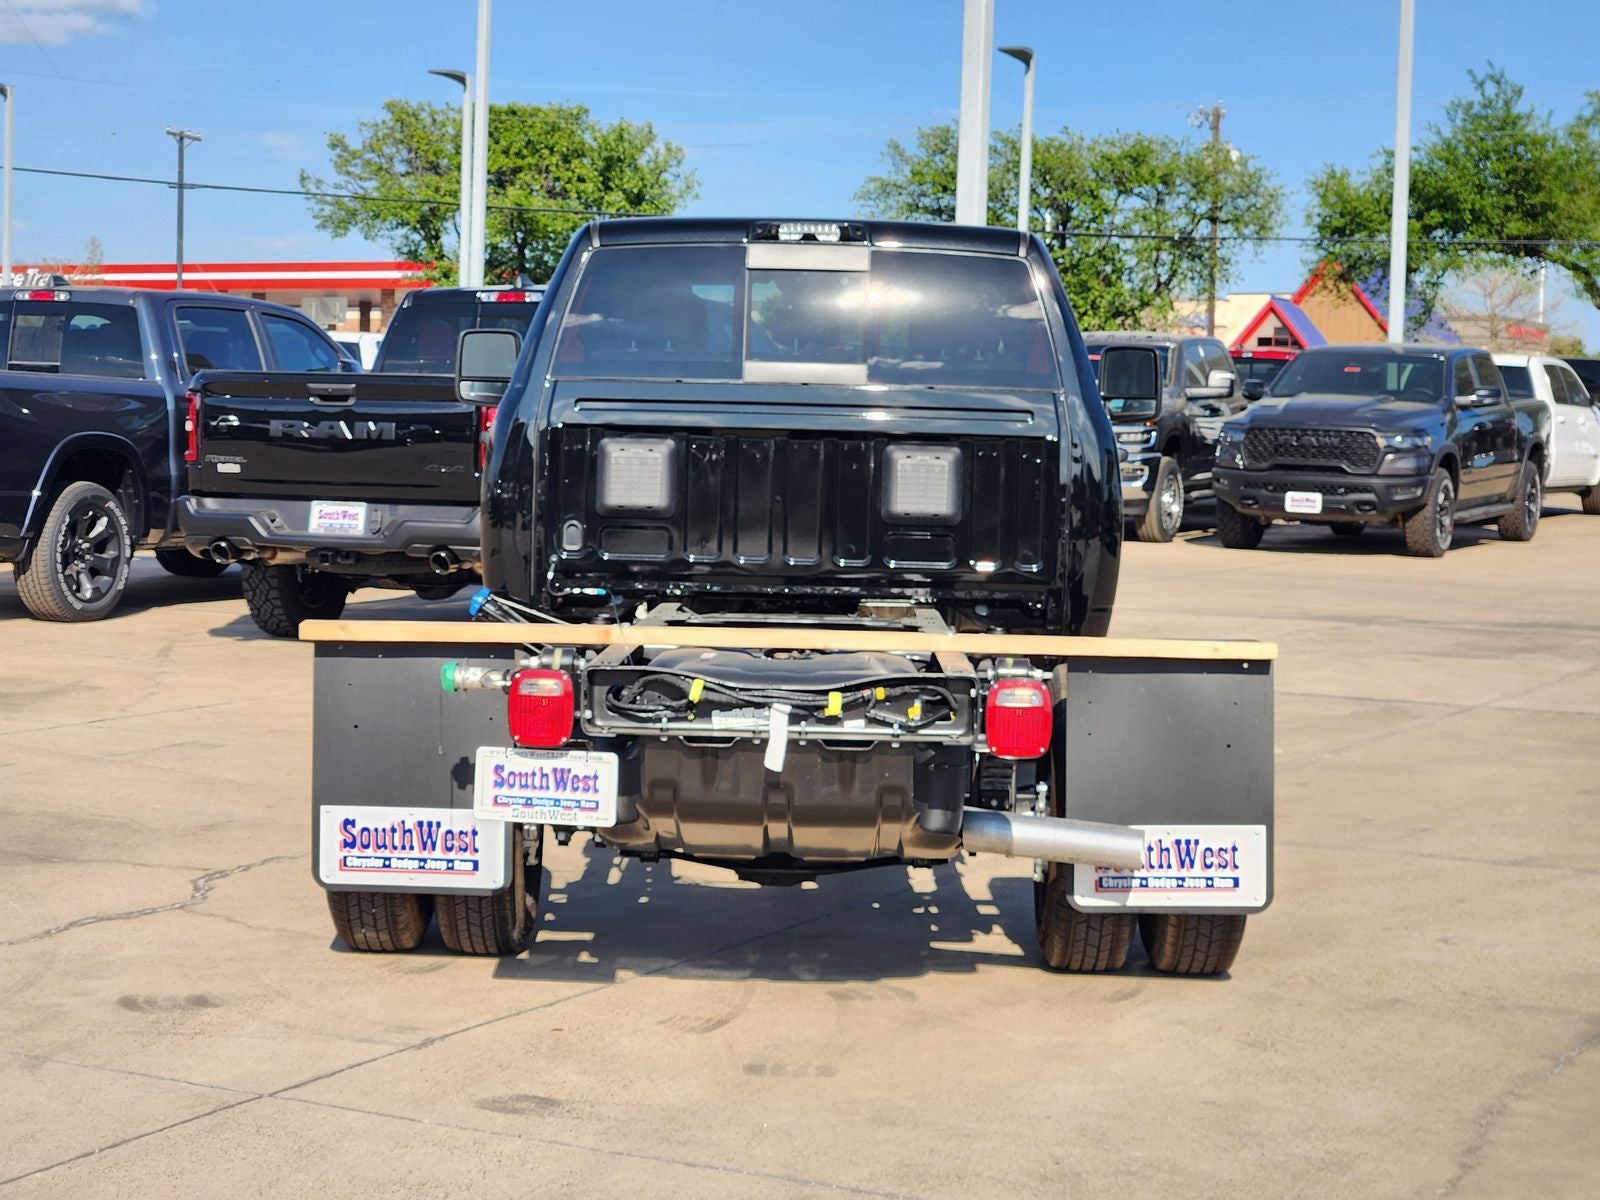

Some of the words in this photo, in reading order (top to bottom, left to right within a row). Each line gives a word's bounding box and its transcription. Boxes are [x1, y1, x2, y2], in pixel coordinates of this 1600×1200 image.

[269, 419, 396, 440] RAM
[494, 763, 599, 793] SouthWest
[496, 795, 526, 805] Chrysler
[532, 797, 554, 807] Dodge
[560, 798, 576, 808] Jeep
[581, 799, 597, 809] Ram
[511, 808, 578, 822] SouthWest
[340, 817, 479, 854] SouthWest
[345, 856, 384, 868] Chrysler
[390, 857, 419, 870] Dodge
[424, 858, 448, 871] Jeep
[453, 859, 474, 871] Ram
[1099, 838, 1239, 872] thWest
[1101, 877, 1141, 889] Chrysler
[1147, 877, 1178, 889] Dodge
[1183, 877, 1207, 889] Jeep
[1213, 877, 1234, 888] Ram
